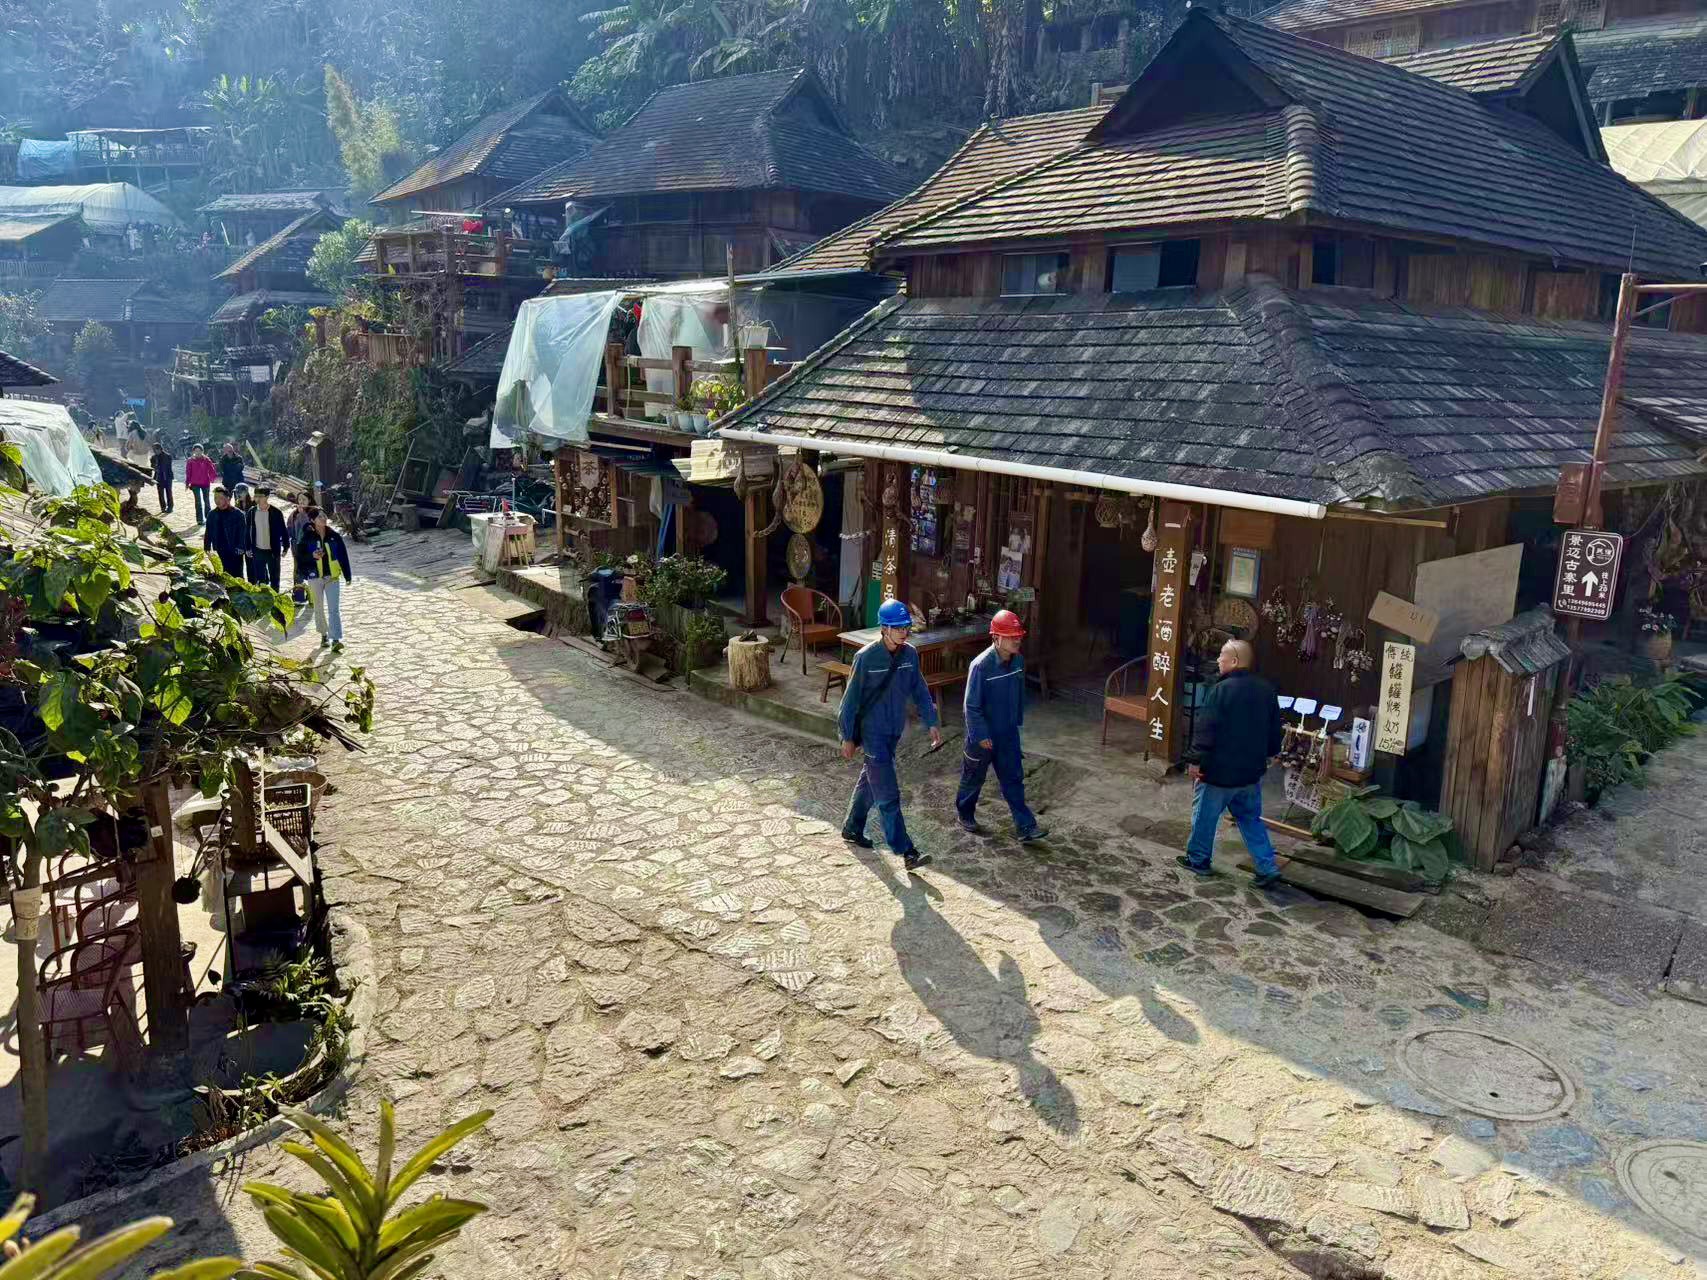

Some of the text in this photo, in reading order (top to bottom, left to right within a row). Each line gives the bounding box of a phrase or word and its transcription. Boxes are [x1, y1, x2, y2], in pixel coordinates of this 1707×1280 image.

[1561, 535, 1583, 596] 景迈古寨里
